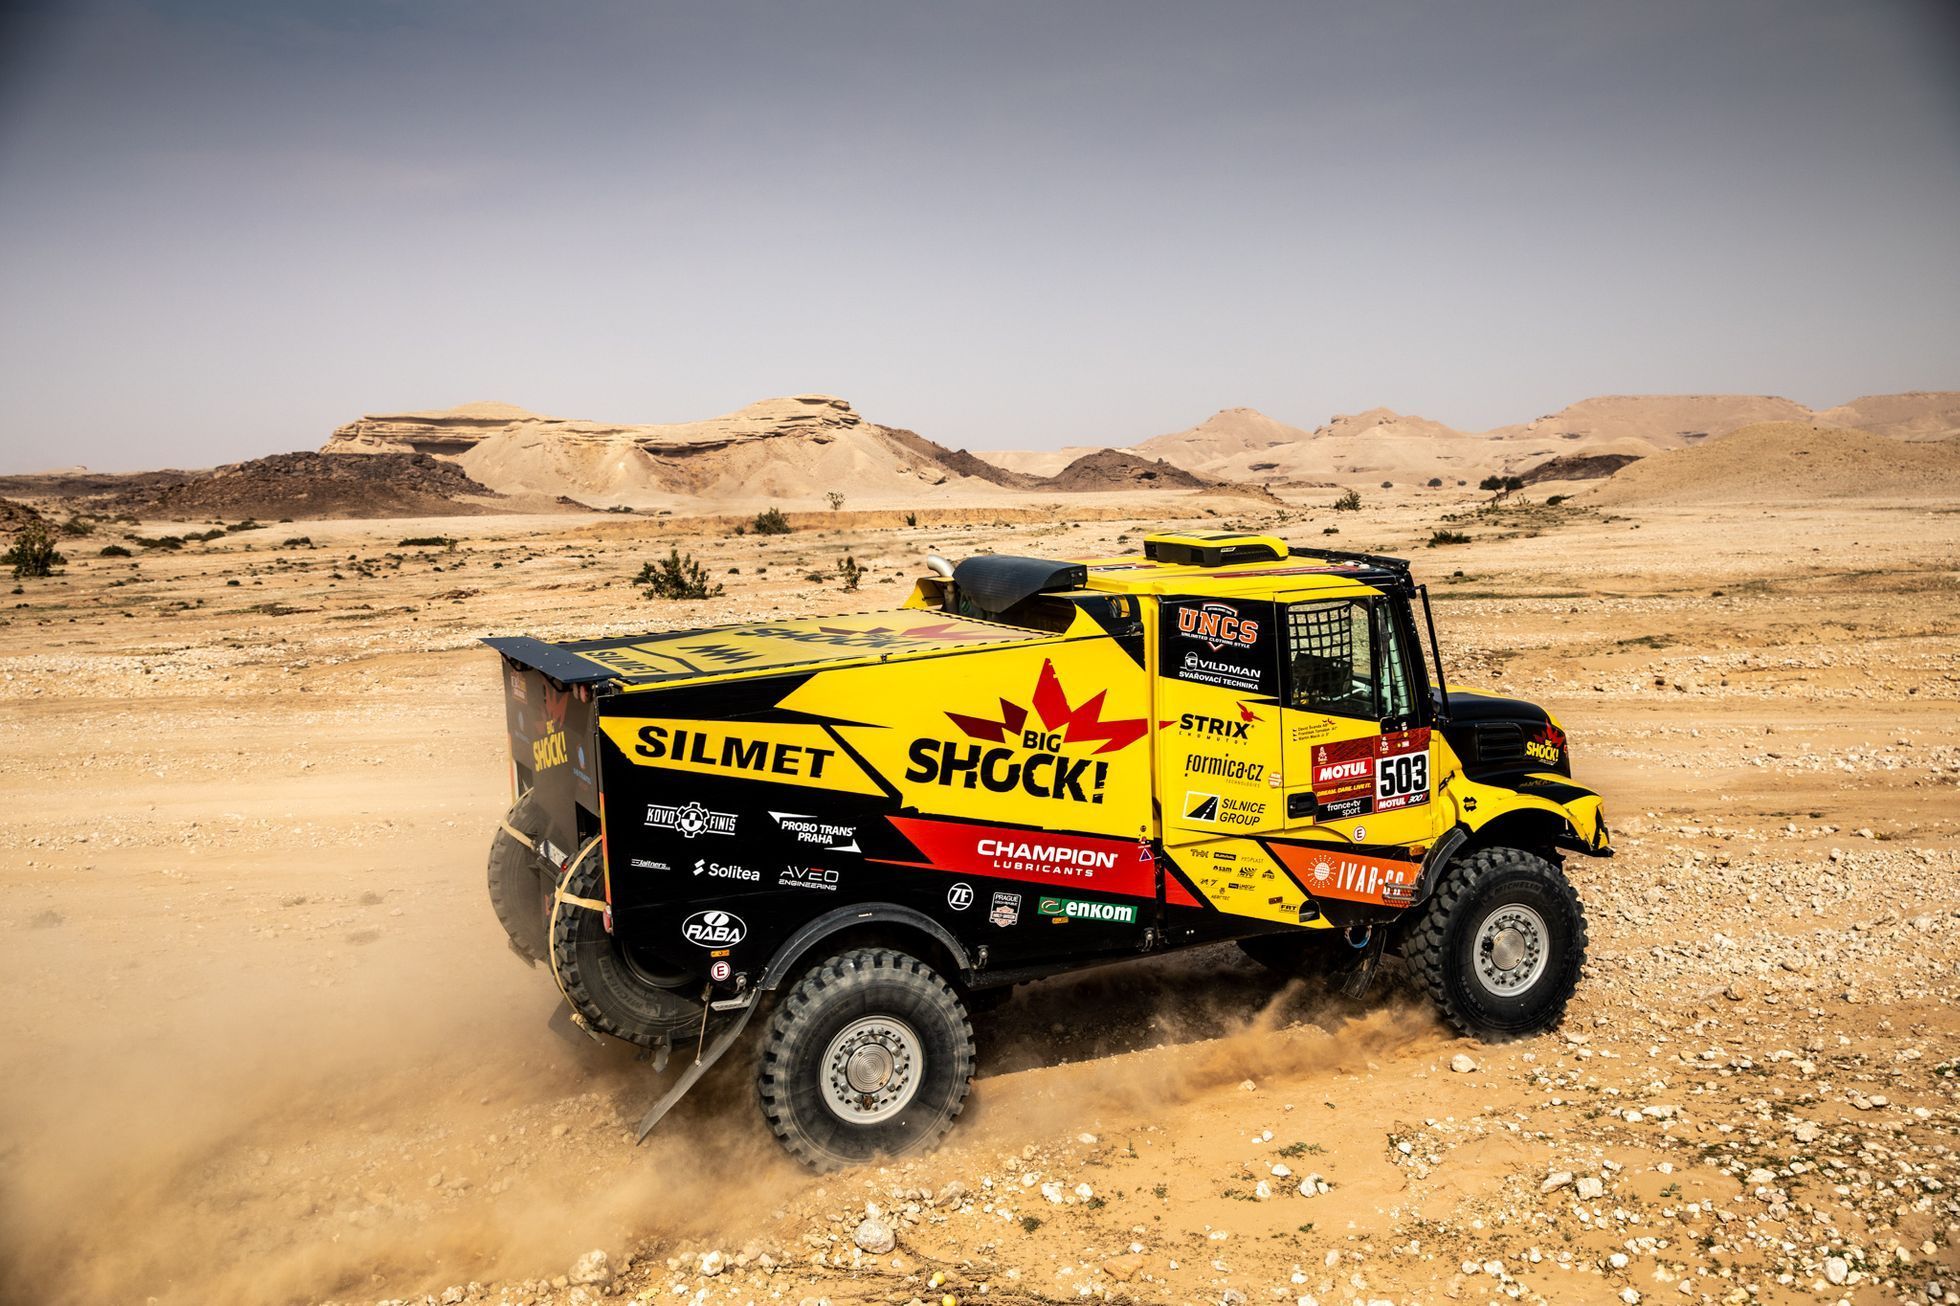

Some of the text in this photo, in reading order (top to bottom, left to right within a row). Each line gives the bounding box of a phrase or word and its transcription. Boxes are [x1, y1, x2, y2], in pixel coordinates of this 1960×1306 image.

[1178, 607, 1259, 644] UNCS
[1199, 659, 1261, 678] VILDMAN
[1222, 678, 1258, 690] TECHNIKA
[1180, 713, 1250, 740] STRIX
[1023, 730, 1062, 753] BIG
[533, 731, 568, 773] SHOCK!
[635, 725, 834, 778] SILMET
[1526, 741, 1559, 762] SHOCK!
[905, 738, 1109, 804] SHOCK!
[1319, 761, 1367, 781] MOTUL
[1380, 754, 1427, 797] 503
[1222, 798, 1266, 814] SILNICE
[1342, 806, 1360, 818] sport
[1378, 797, 1406, 810] MOTUL
[646, 808, 675, 824] KOVO
[1220, 812, 1260, 826] GROUP
[781, 820, 853, 837] PROBO TRANS
[798, 832, 833, 844] PRAHA
[977, 839, 1116, 869] CHAMPION
[708, 862, 760, 882] Solitea
[780, 865, 839, 883] AVEO
[994, 860, 1094, 877] LUBRICANTS
[778, 878, 838, 891] ENGINEERING
[952, 888, 971, 905] ZF
[1066, 902, 1132, 922] enkom
[716, 966, 725, 976] E
